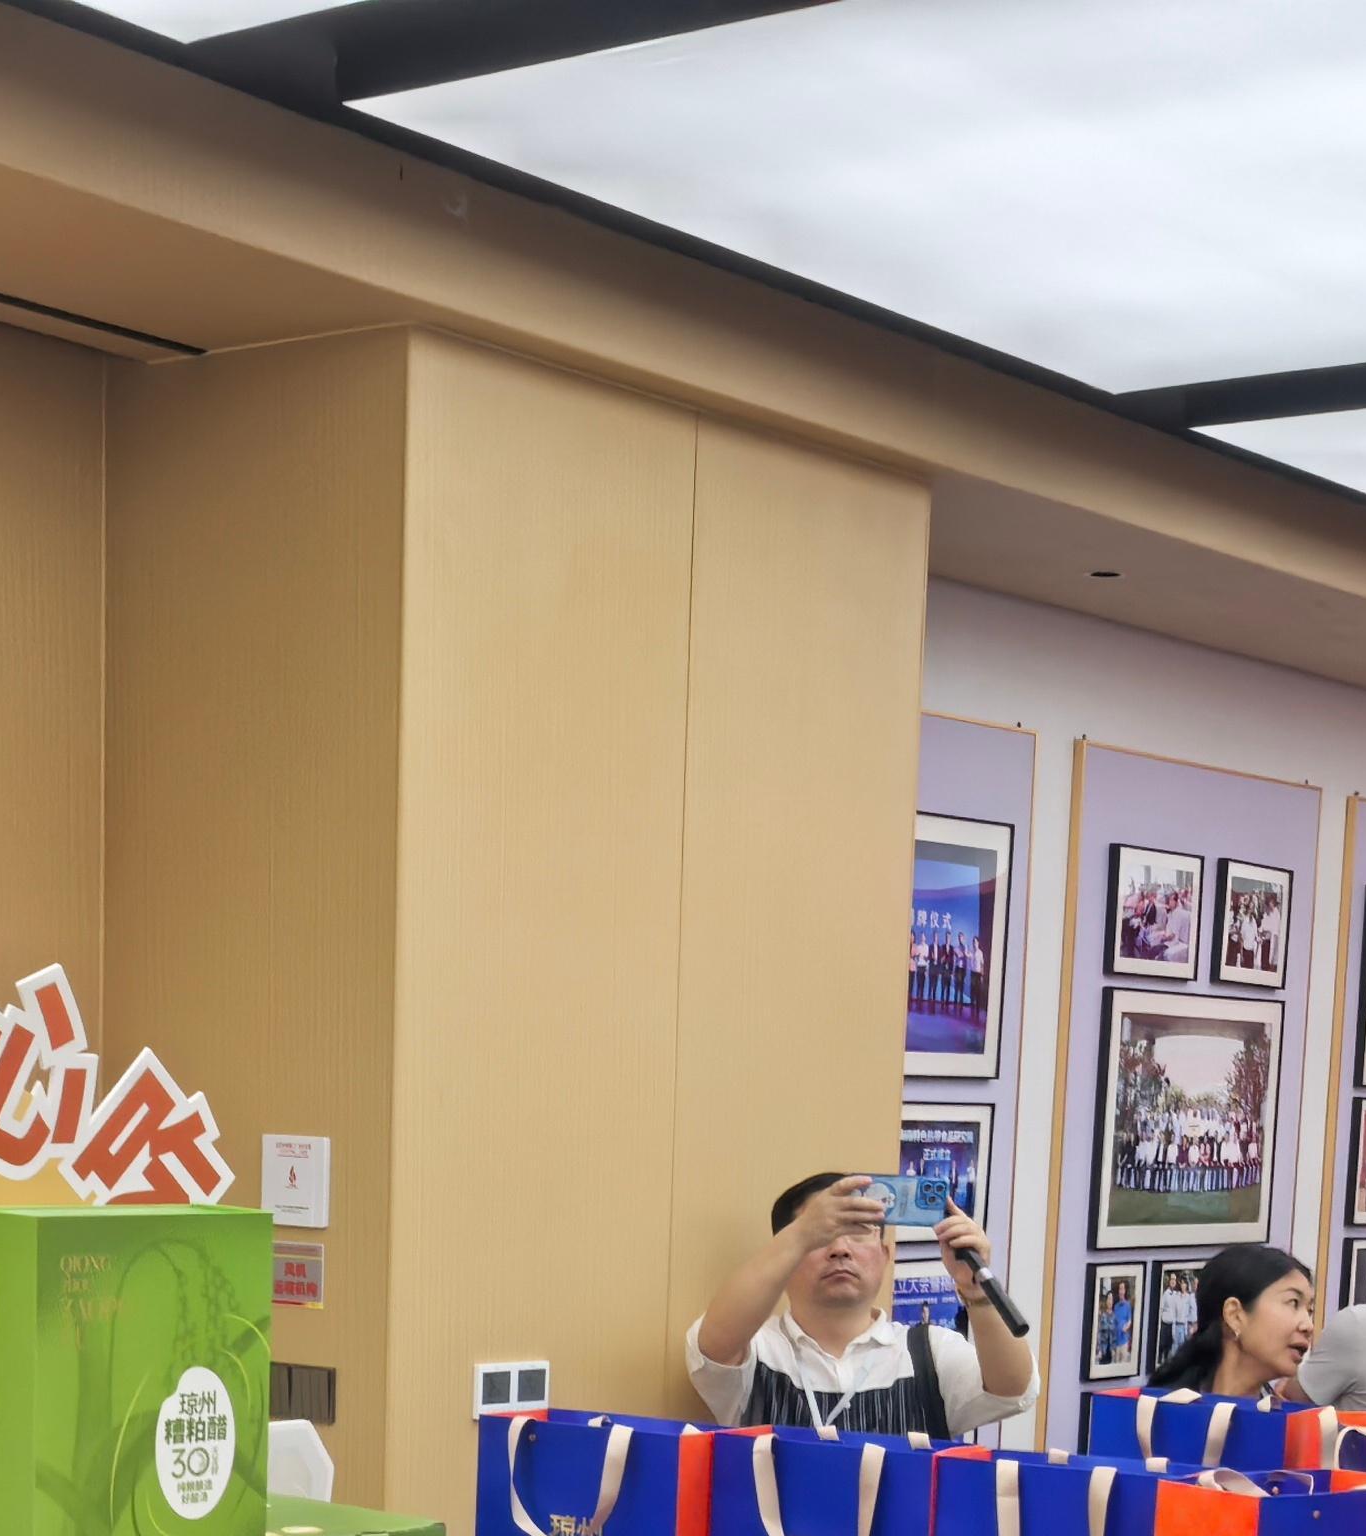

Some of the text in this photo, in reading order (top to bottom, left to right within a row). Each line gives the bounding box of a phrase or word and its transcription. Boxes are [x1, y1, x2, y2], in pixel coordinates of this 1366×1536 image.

[911, 908, 953, 930] 牌仪式
[179, 1390, 217, 1417] 琼州
[164, 1414, 228, 1446] 糟粕醋
